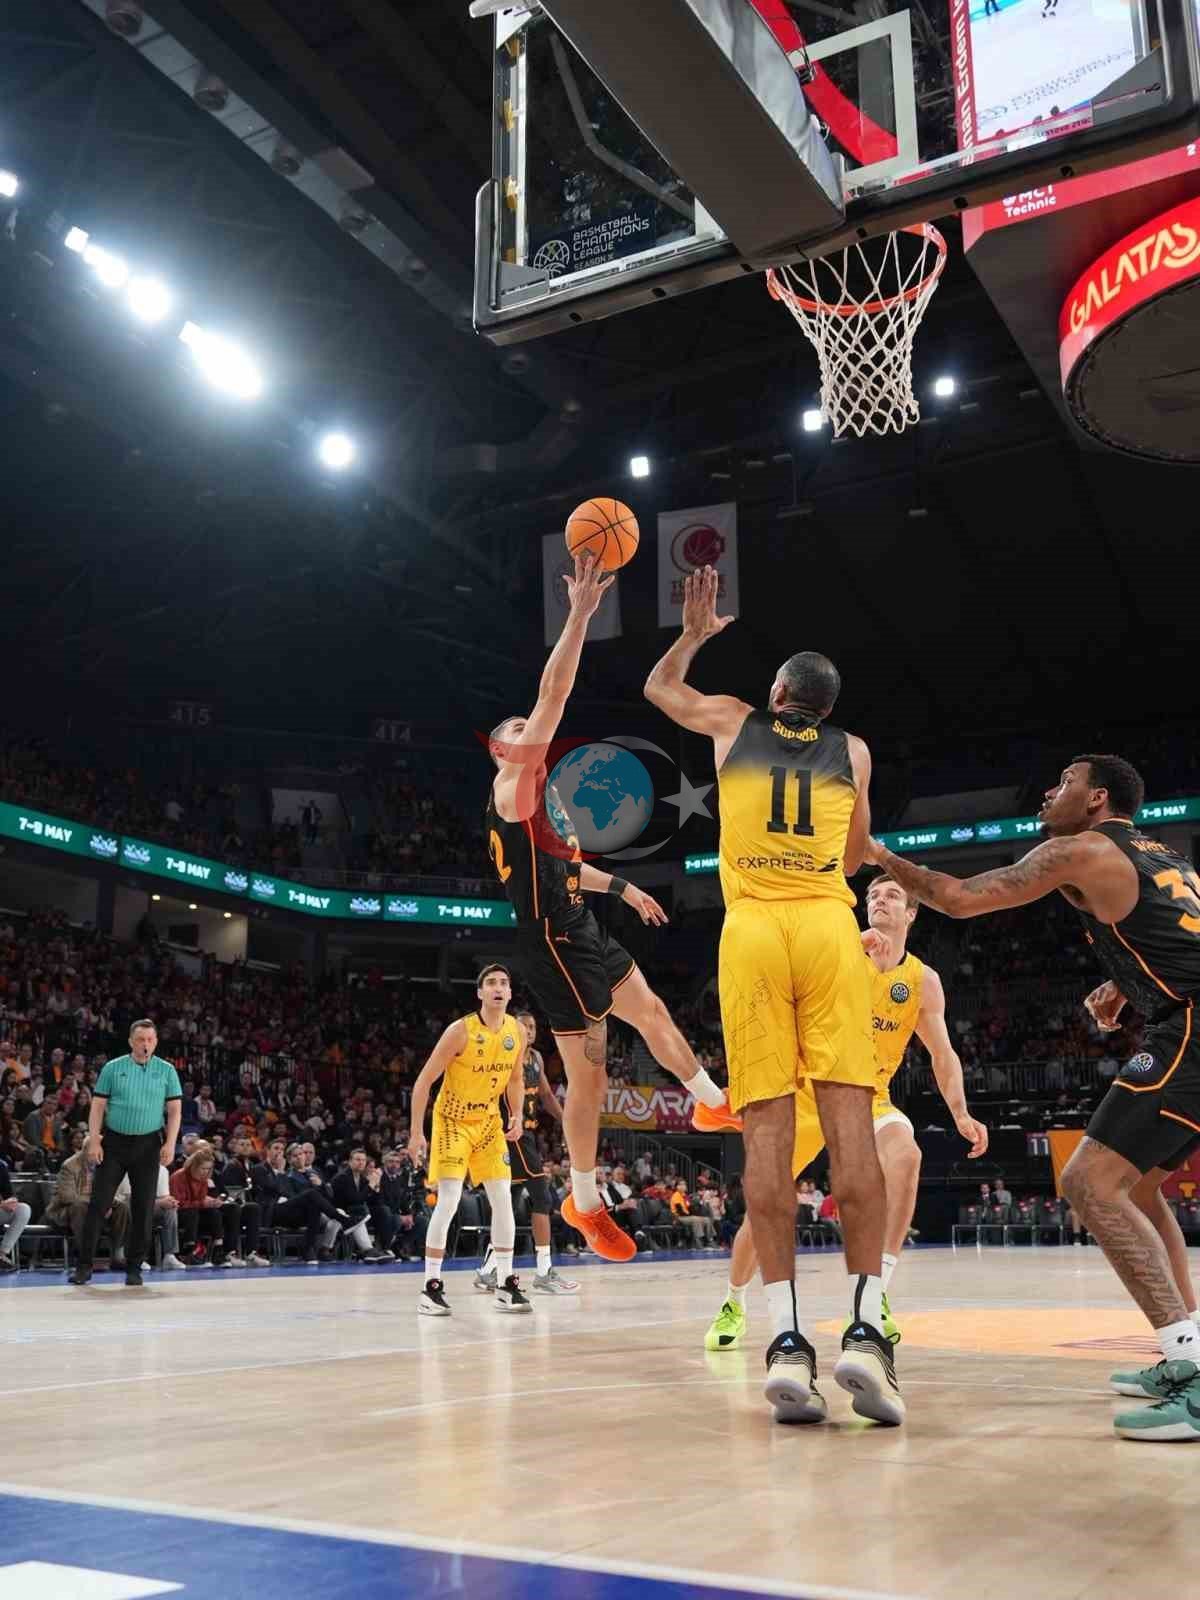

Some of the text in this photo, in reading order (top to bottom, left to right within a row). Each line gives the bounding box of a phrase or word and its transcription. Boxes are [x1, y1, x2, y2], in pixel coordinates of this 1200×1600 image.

[1004, 196, 1057, 218] Technic
[573, 212, 641, 241] BASKETBALL
[573, 218, 650, 252] CHAMPIONS
[573, 240, 615, 261] LEAGUE
[767, 767, 814, 836] 11
[1163, 804, 1187, 816] MAY
[44, 823, 73, 843] MAY
[187, 862, 211, 880] MAY
[737, 857, 815, 873] EXPRESS
[306, 894, 331, 909] MAY
[464, 906, 492, 920] MAY
